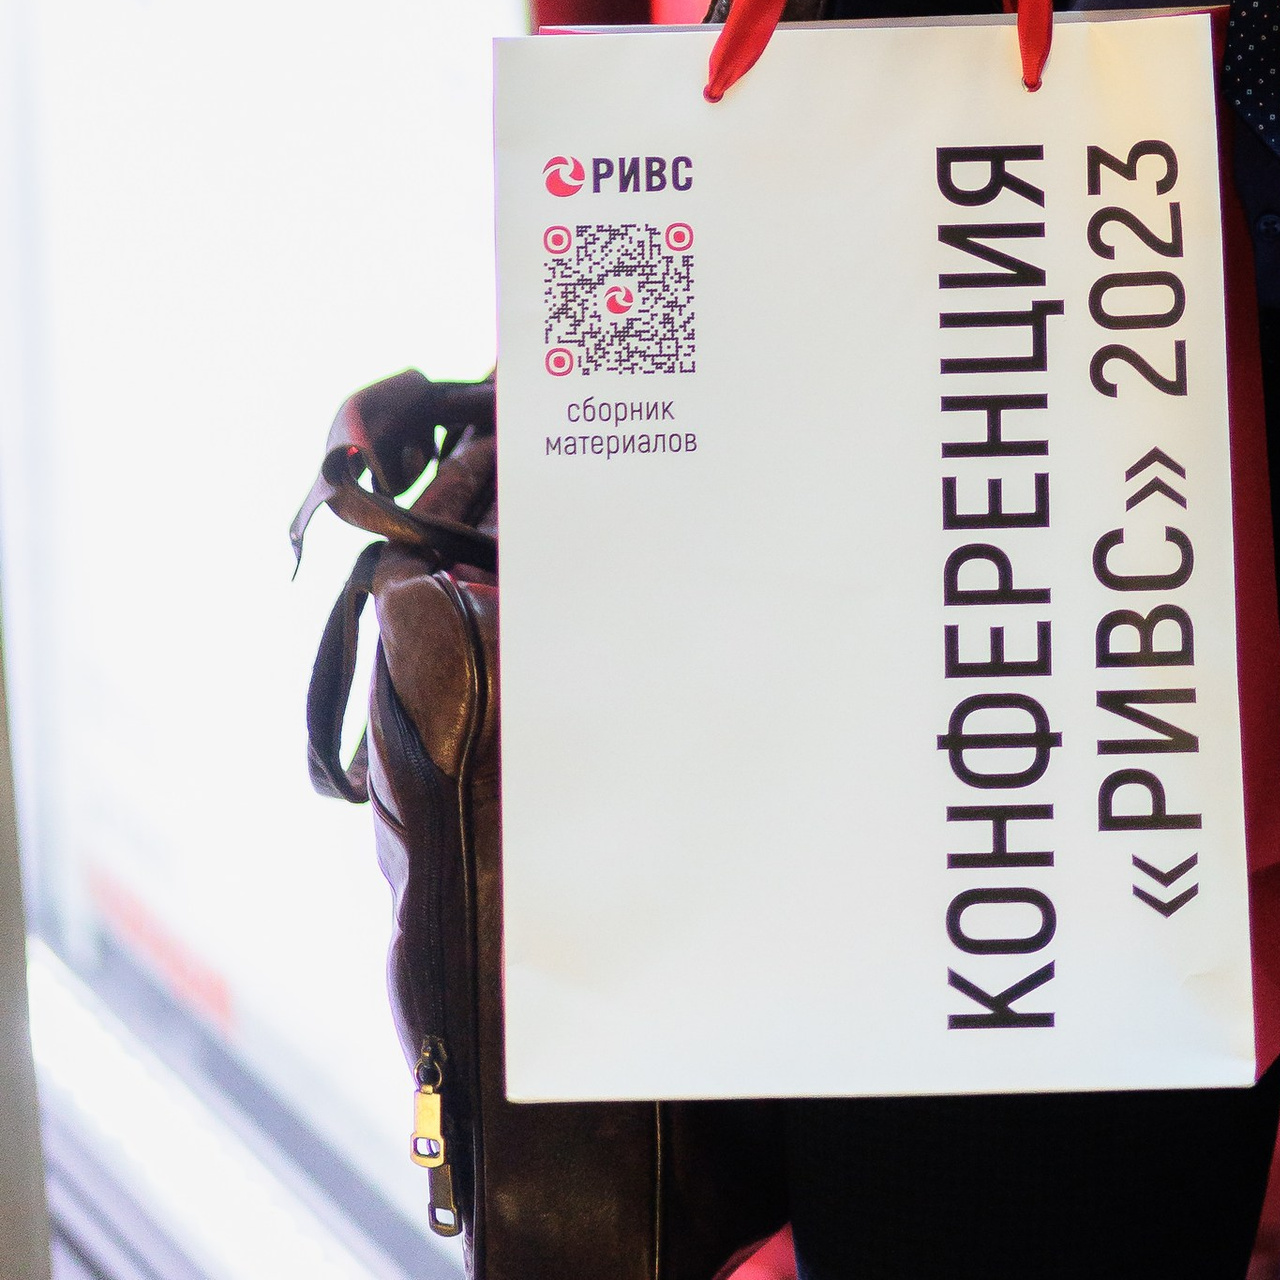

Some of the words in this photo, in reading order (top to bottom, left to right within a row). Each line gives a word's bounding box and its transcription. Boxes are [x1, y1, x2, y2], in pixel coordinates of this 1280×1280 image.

[592, 155, 694, 194] РИВС
[1087, 138, 1189, 398] 2023
[545, 432, 698, 460] материалов
[567, 396, 676, 428] сборник
[936, 144, 1065, 1030] КОНФЕРЕНЦИЯ
[1092, 444, 1203, 919] «РИВС»
